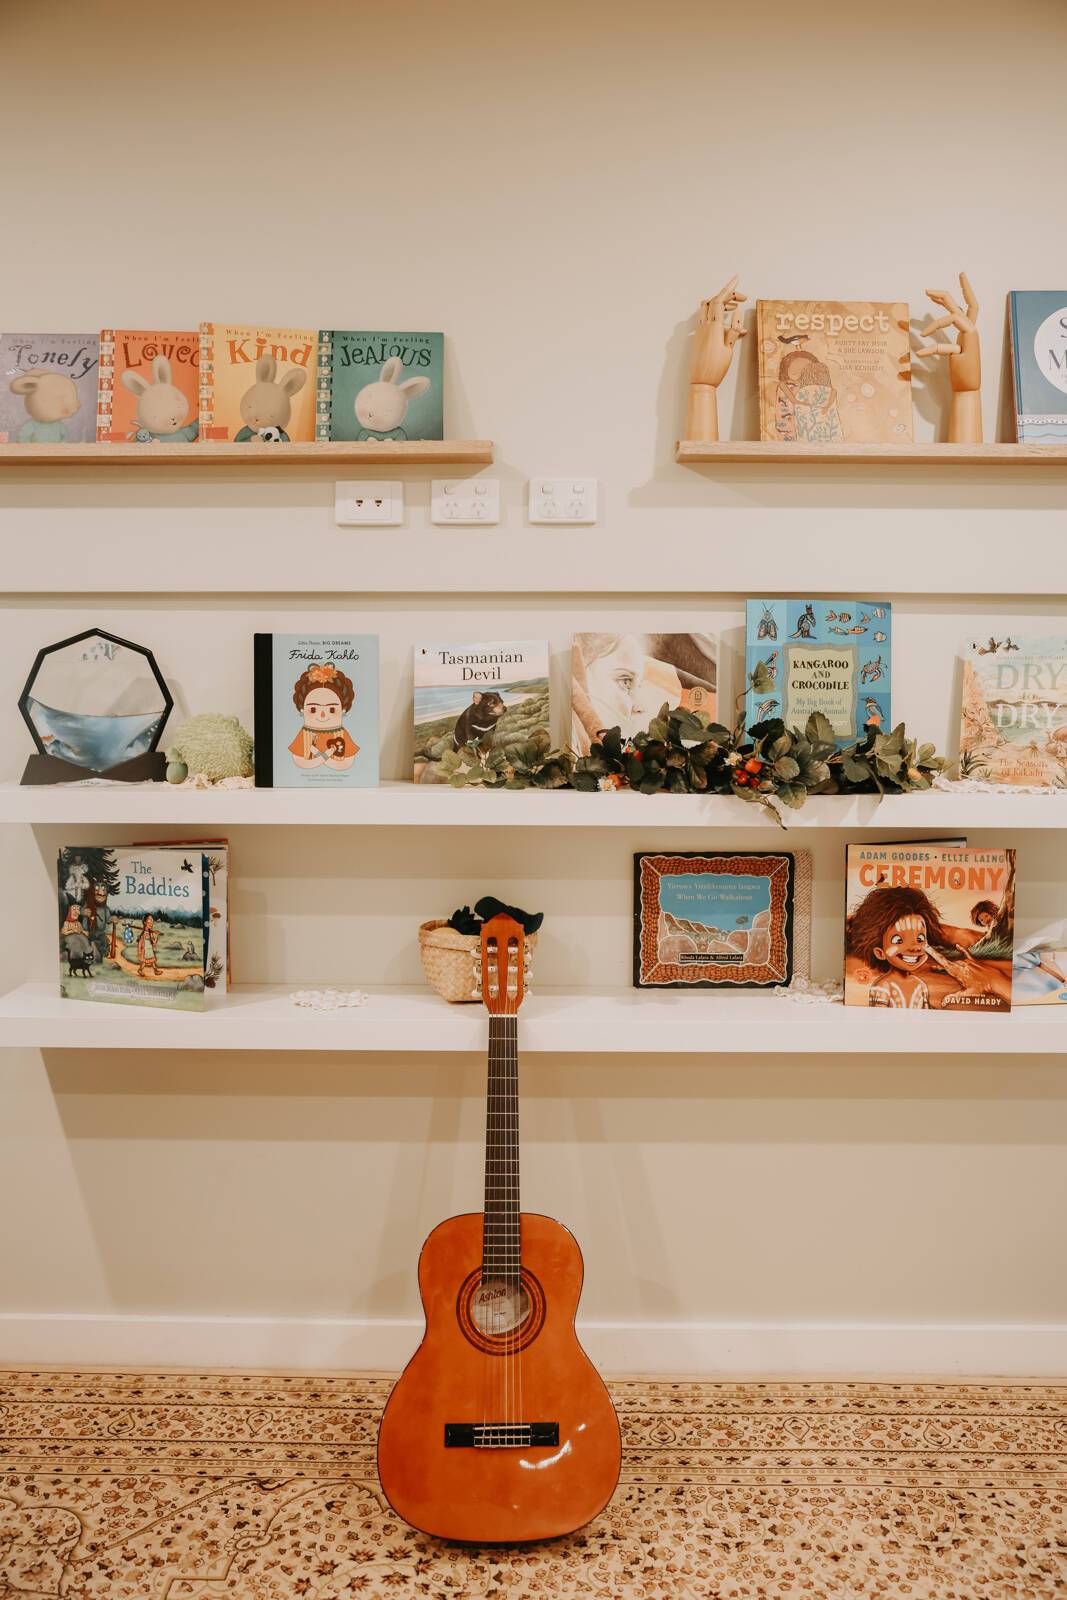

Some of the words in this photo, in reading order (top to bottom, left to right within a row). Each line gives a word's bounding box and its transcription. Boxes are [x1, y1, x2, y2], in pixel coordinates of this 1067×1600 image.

[776, 310, 890, 336] respect
[225, 338, 313, 368] Kind
[288, 649, 323, 660] Frida
[324, 649, 360, 661] Kahlo
[438, 651, 524, 665] Tasmanian
[793, 660, 849, 669] KANGAROO
[461, 667, 502, 681] Devil
[812, 671, 831, 679] AND
[994, 663, 1067, 690] DRY
[791, 680, 850, 691] CROCODILE
[996, 703, 1063, 729] DRY
[859, 851, 888, 860] ADAM
[891, 852, 931, 861] GOODES
[941, 853, 969, 862] ELLIE
[974, 854, 1005, 863] LAING
[130, 861, 152, 875] The
[858, 863, 1004, 892] CEREMONY
[125, 875, 190, 898] Baddies
[944, 996, 971, 1005] DAVID
[974, 998, 1001, 1006] HARDY
[479, 1289, 507, 1304] Ashton
